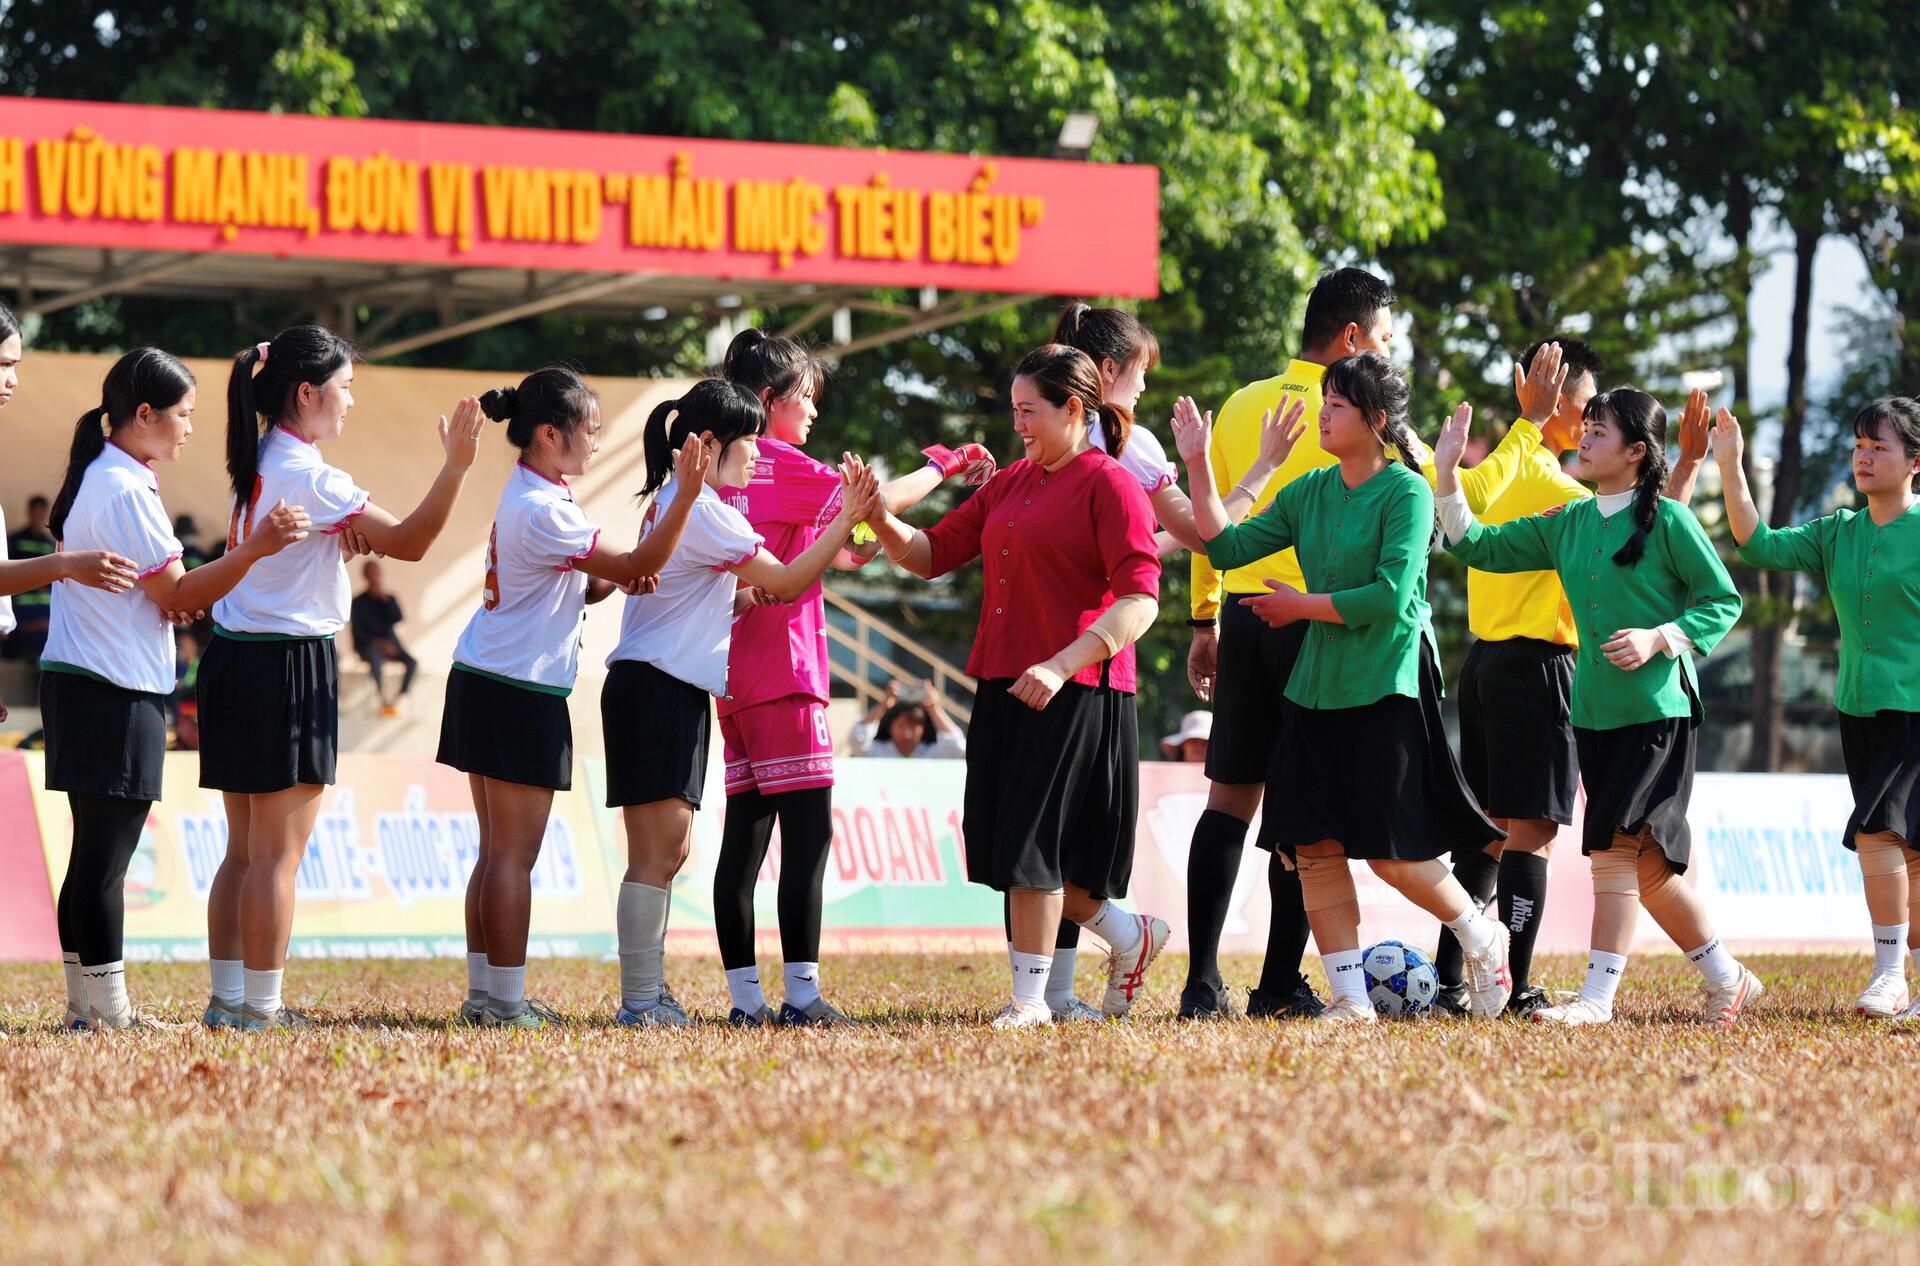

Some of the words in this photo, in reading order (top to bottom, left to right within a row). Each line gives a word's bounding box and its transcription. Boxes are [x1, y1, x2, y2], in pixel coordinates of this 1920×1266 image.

[36, 124, 164, 221] VỮNG
[173, 145, 320, 241] MẠNH,
[325, 150, 419, 236] ĐƠN
[429, 161, 472, 252] VỊ
[483, 163, 601, 244] VMTD
[734, 175, 827, 269] MỰC
[834, 170, 922, 260] TIÊU
[812, 709, 829, 746] 8
[831, 789, 943, 882] ĐOÀN
[1509, 894, 1534, 932] Mitre
